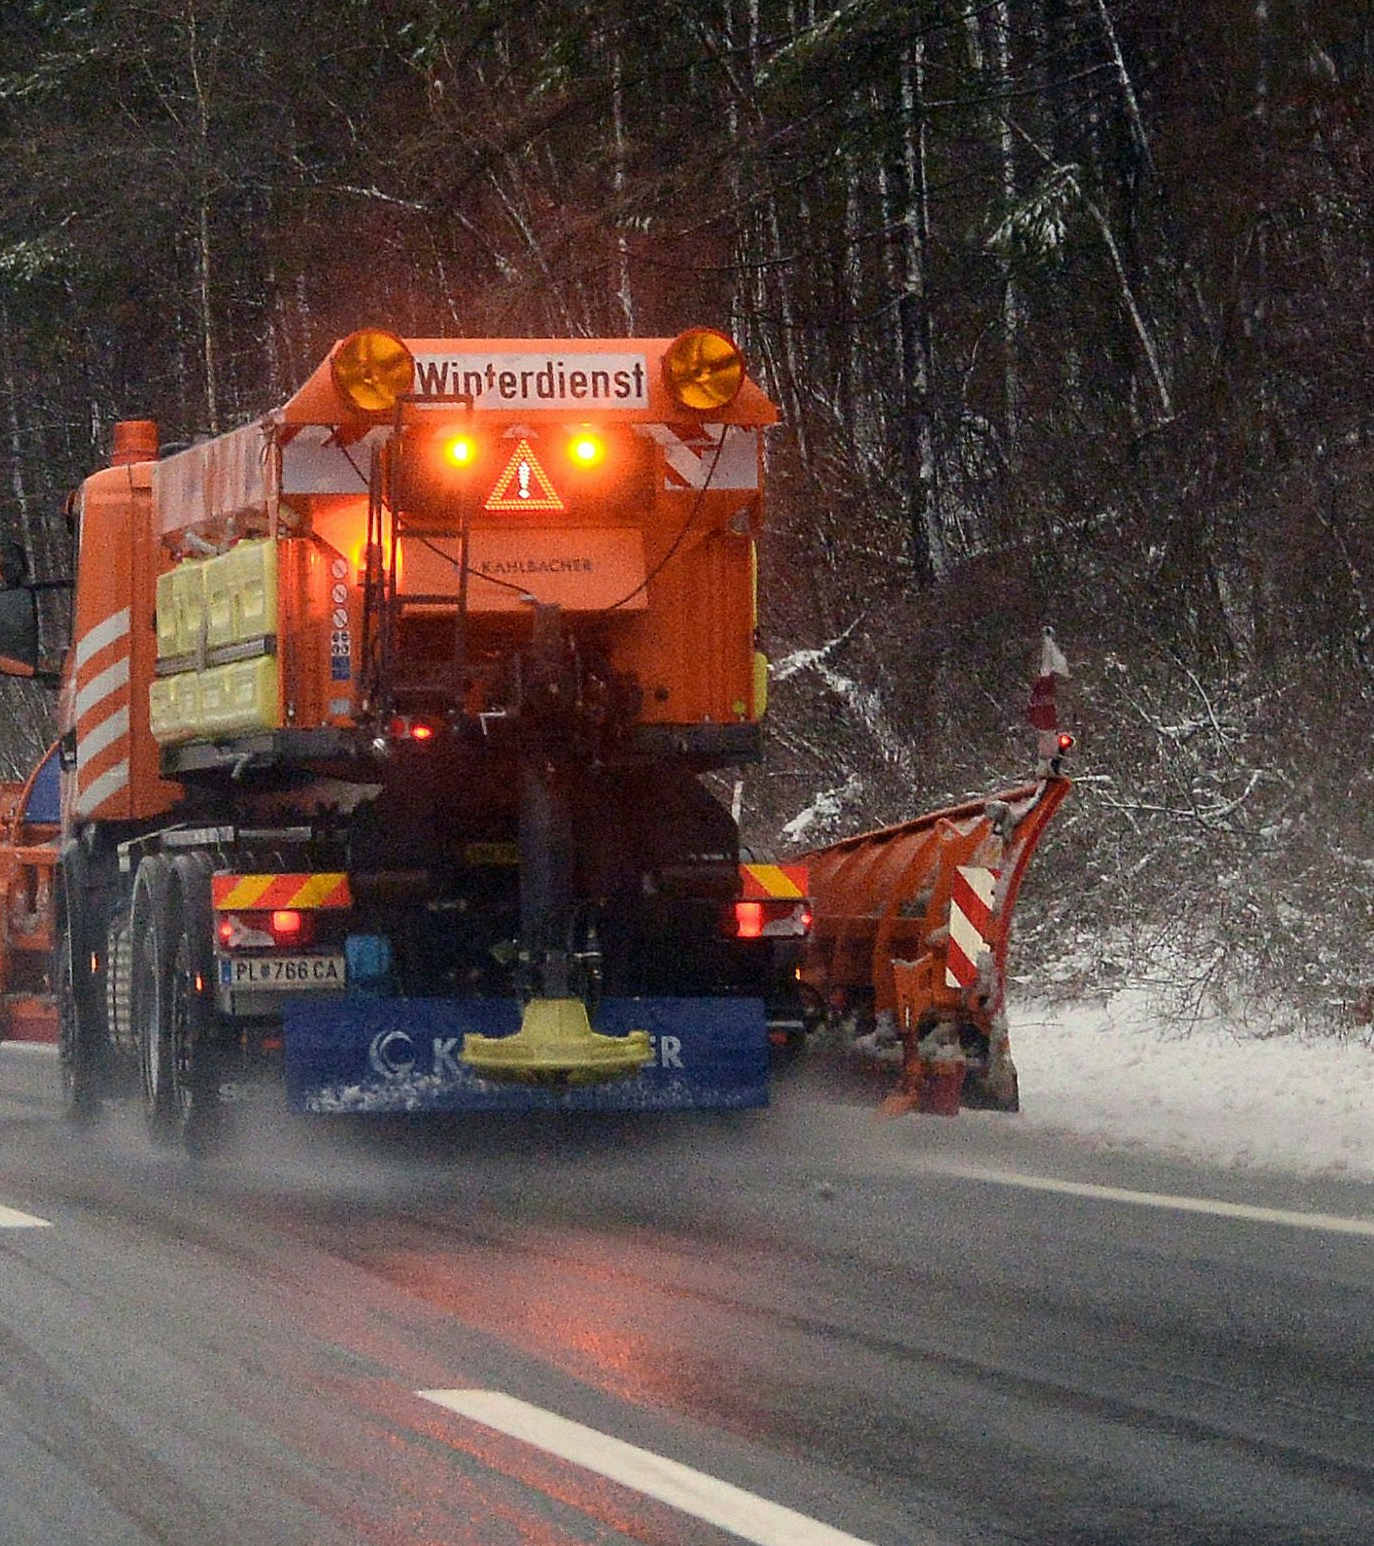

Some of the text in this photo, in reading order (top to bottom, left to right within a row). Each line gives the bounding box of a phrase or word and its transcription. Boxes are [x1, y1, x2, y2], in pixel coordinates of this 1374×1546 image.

[416, 361, 644, 399] Winterdienst
[482, 559, 592, 574] KAHLBACHER
[236, 960, 338, 981] PL 766 CA
